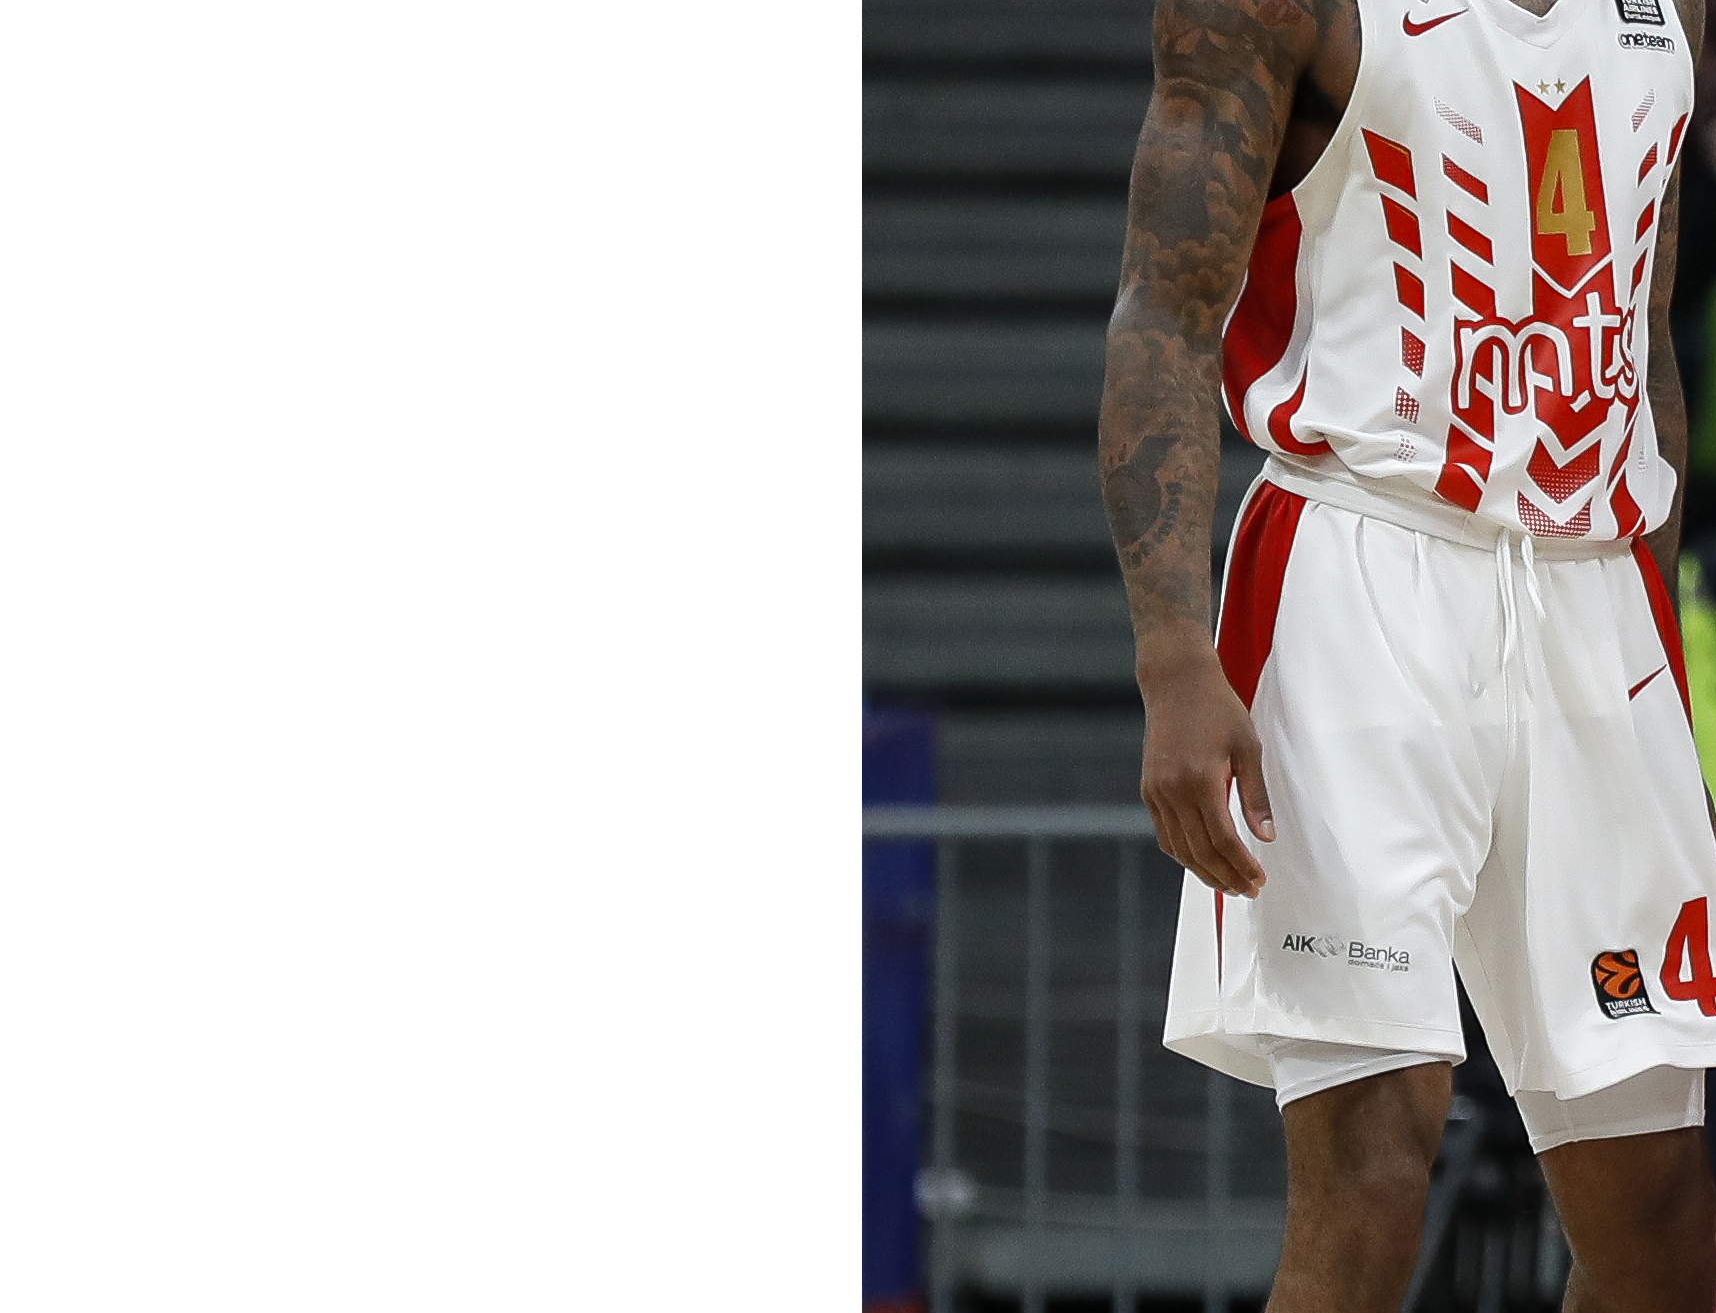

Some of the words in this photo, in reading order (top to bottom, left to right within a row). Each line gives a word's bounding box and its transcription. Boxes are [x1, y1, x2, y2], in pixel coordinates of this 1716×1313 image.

[1620, 32, 1675, 51] oneteam
[1538, 129, 1596, 255] 4
[1457, 290, 1639, 410] mts
[1282, 933, 1317, 954] AIK
[1348, 940, 1411, 965] Banka
[1605, 998, 1647, 1010] TURKISH
